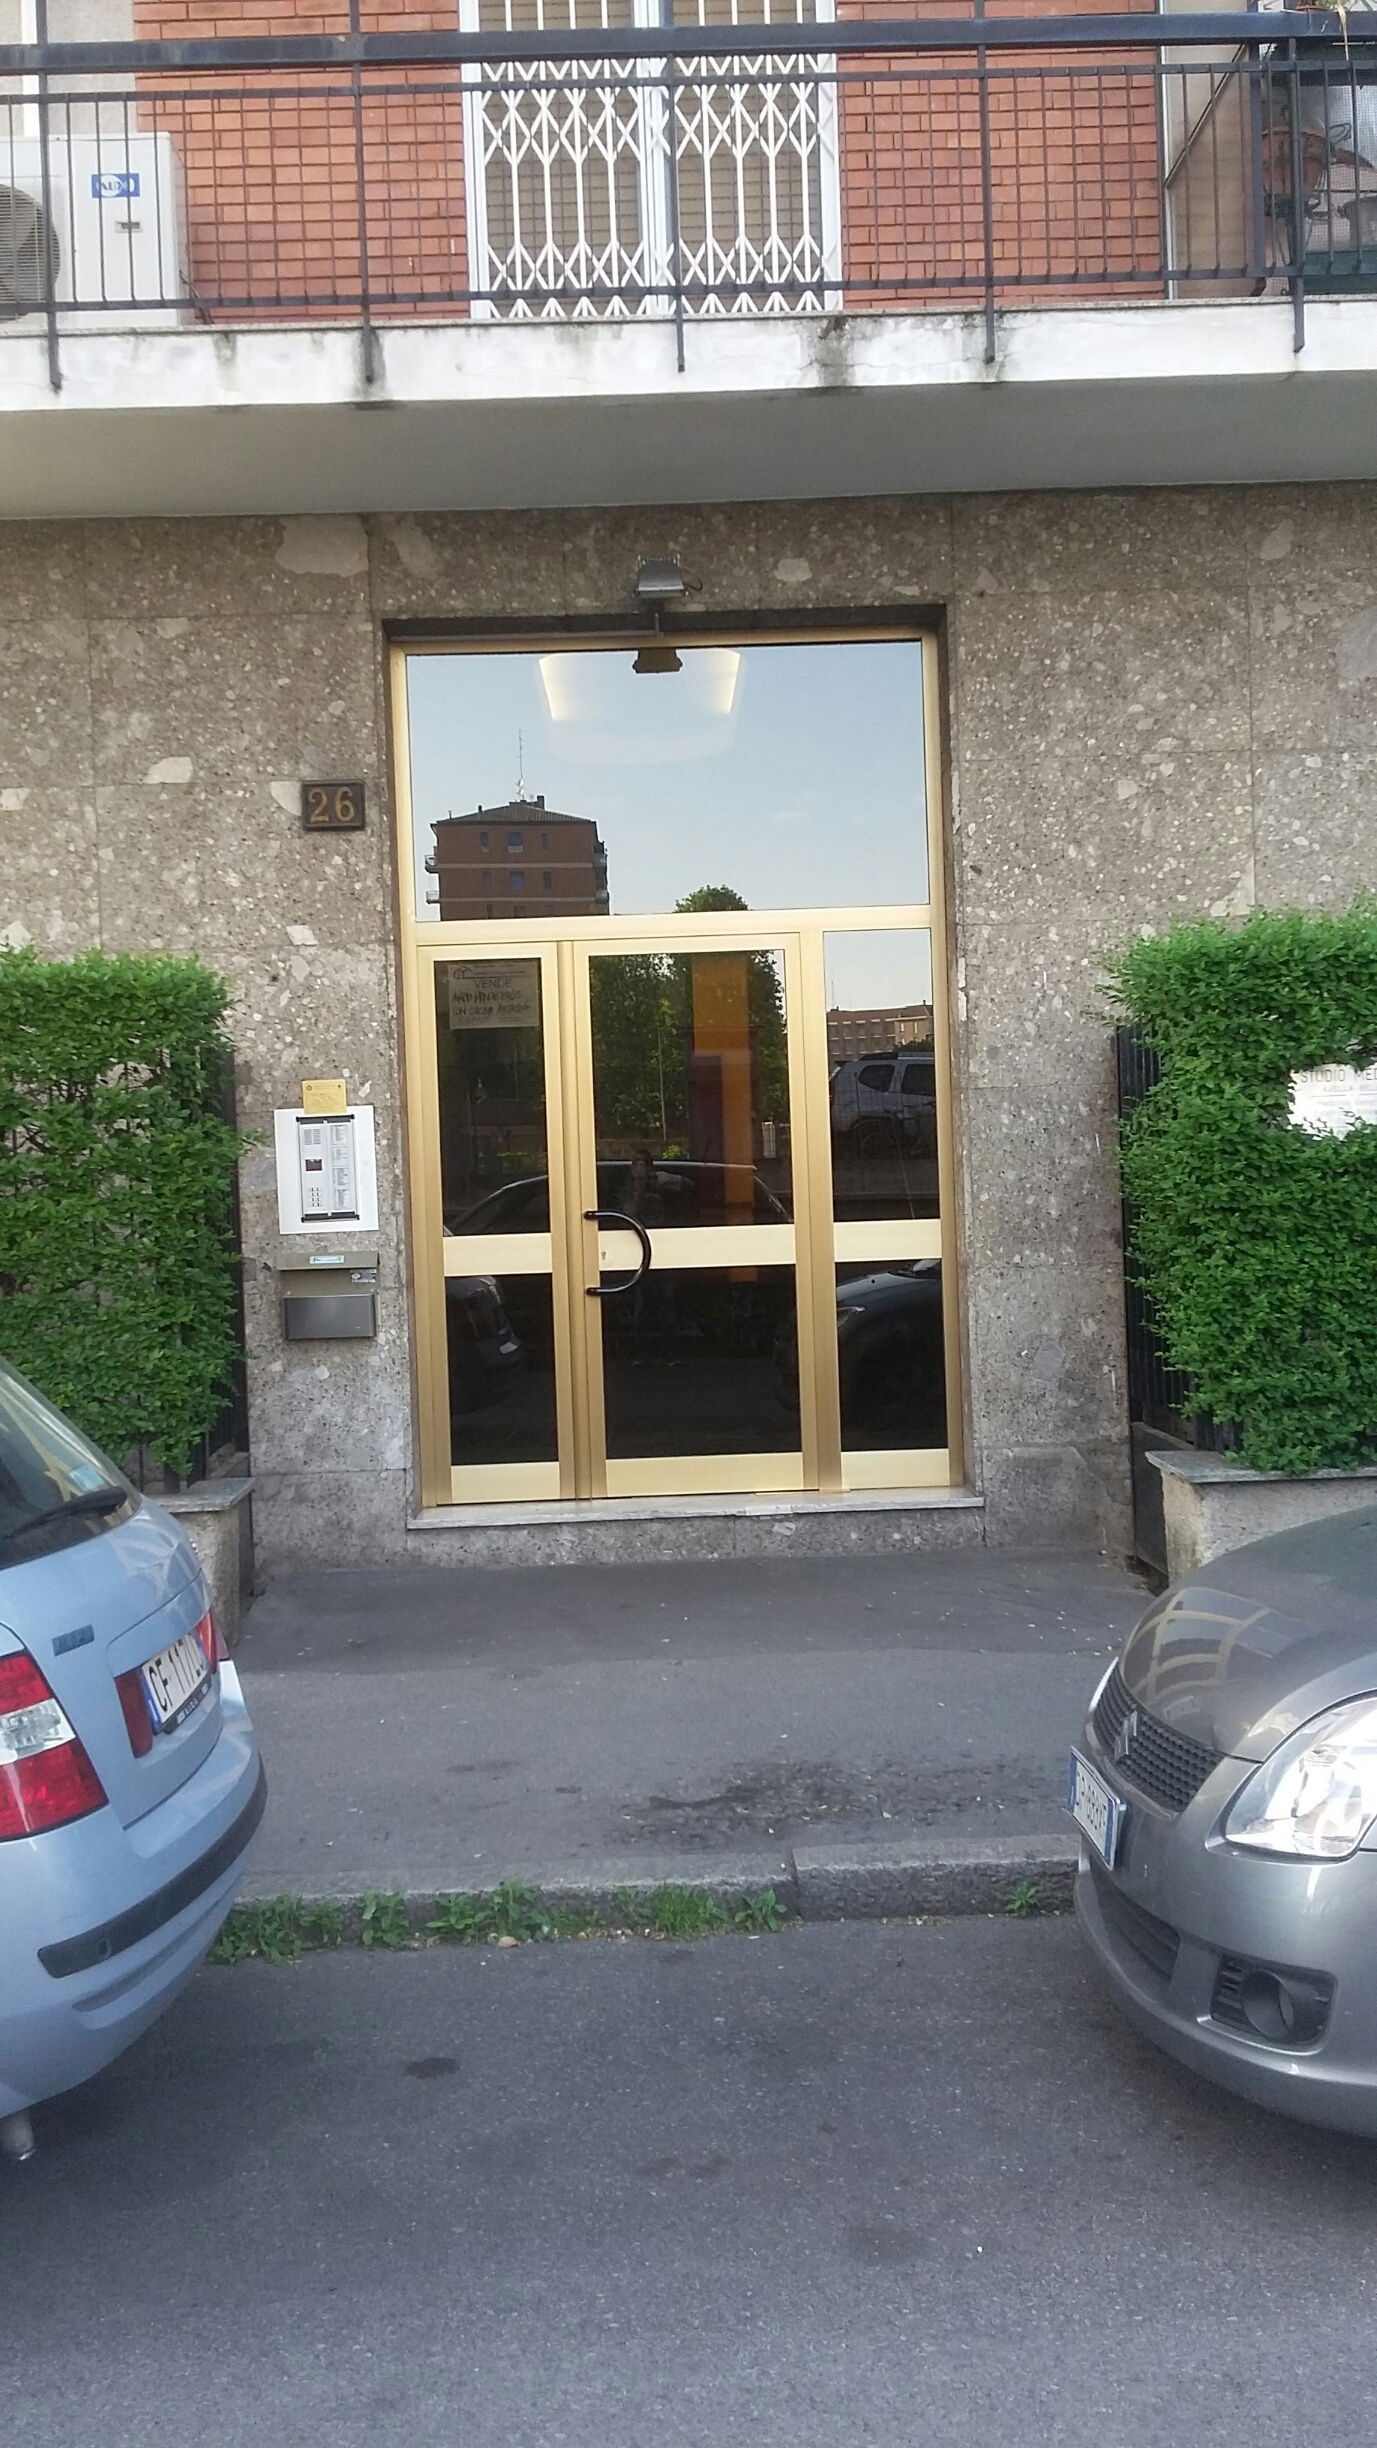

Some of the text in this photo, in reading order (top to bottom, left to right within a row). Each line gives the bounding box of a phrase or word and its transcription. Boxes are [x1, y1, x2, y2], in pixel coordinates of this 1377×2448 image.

[308, 786, 355, 823] 26
[473, 978, 512, 989] VENDE
[1300, 1068, 1346, 1083] STUDIO
